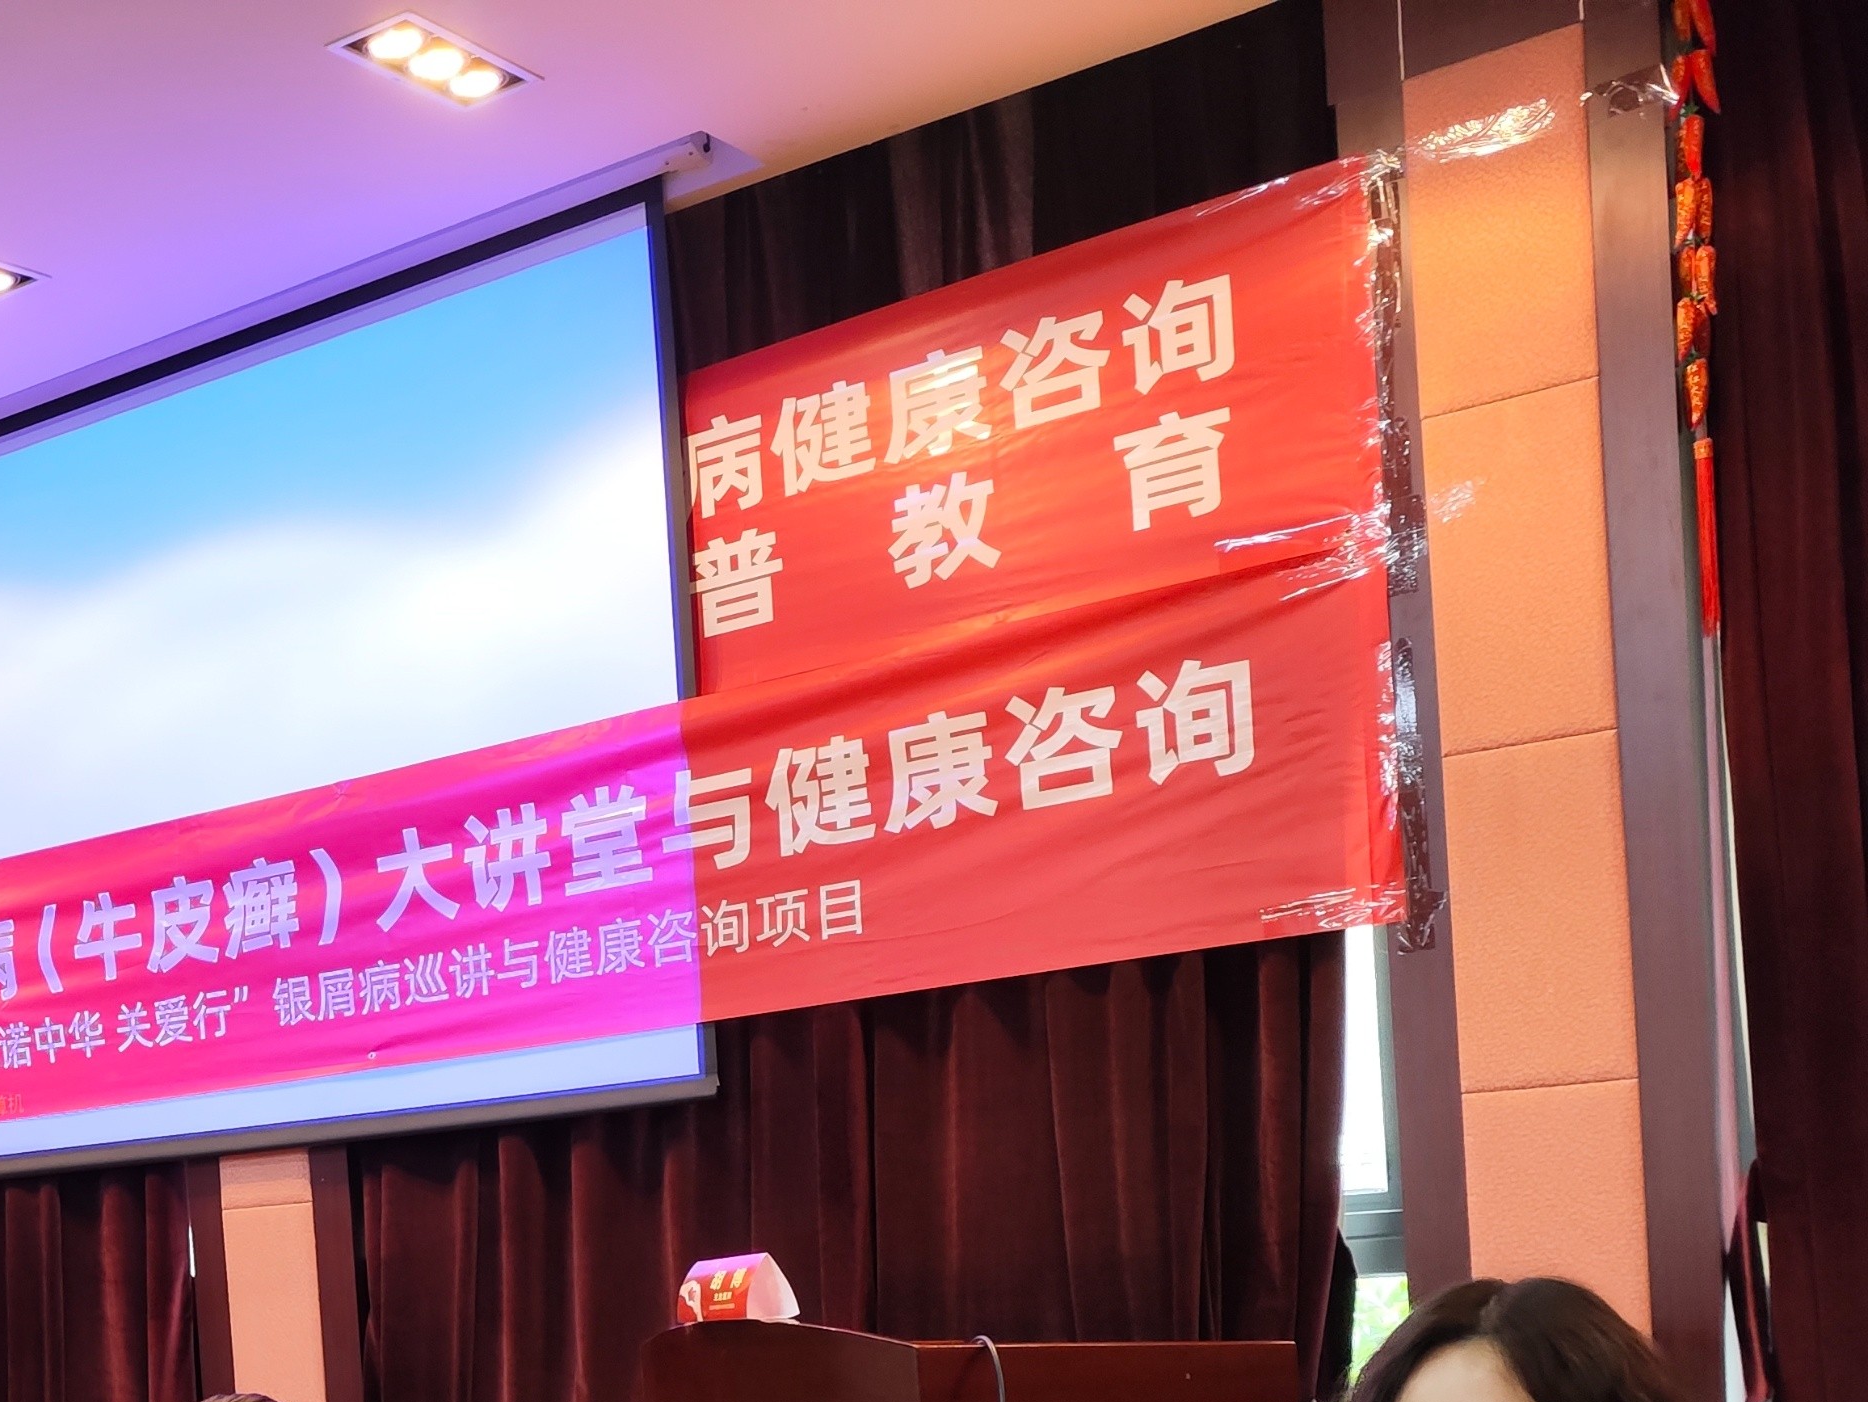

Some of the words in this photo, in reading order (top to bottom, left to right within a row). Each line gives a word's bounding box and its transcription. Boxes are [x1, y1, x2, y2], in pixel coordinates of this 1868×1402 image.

[687, 273, 1236, 520] 病健康咨询
[272, 878, 866, 1027] 银屑病巡讲与健康咨询项目
